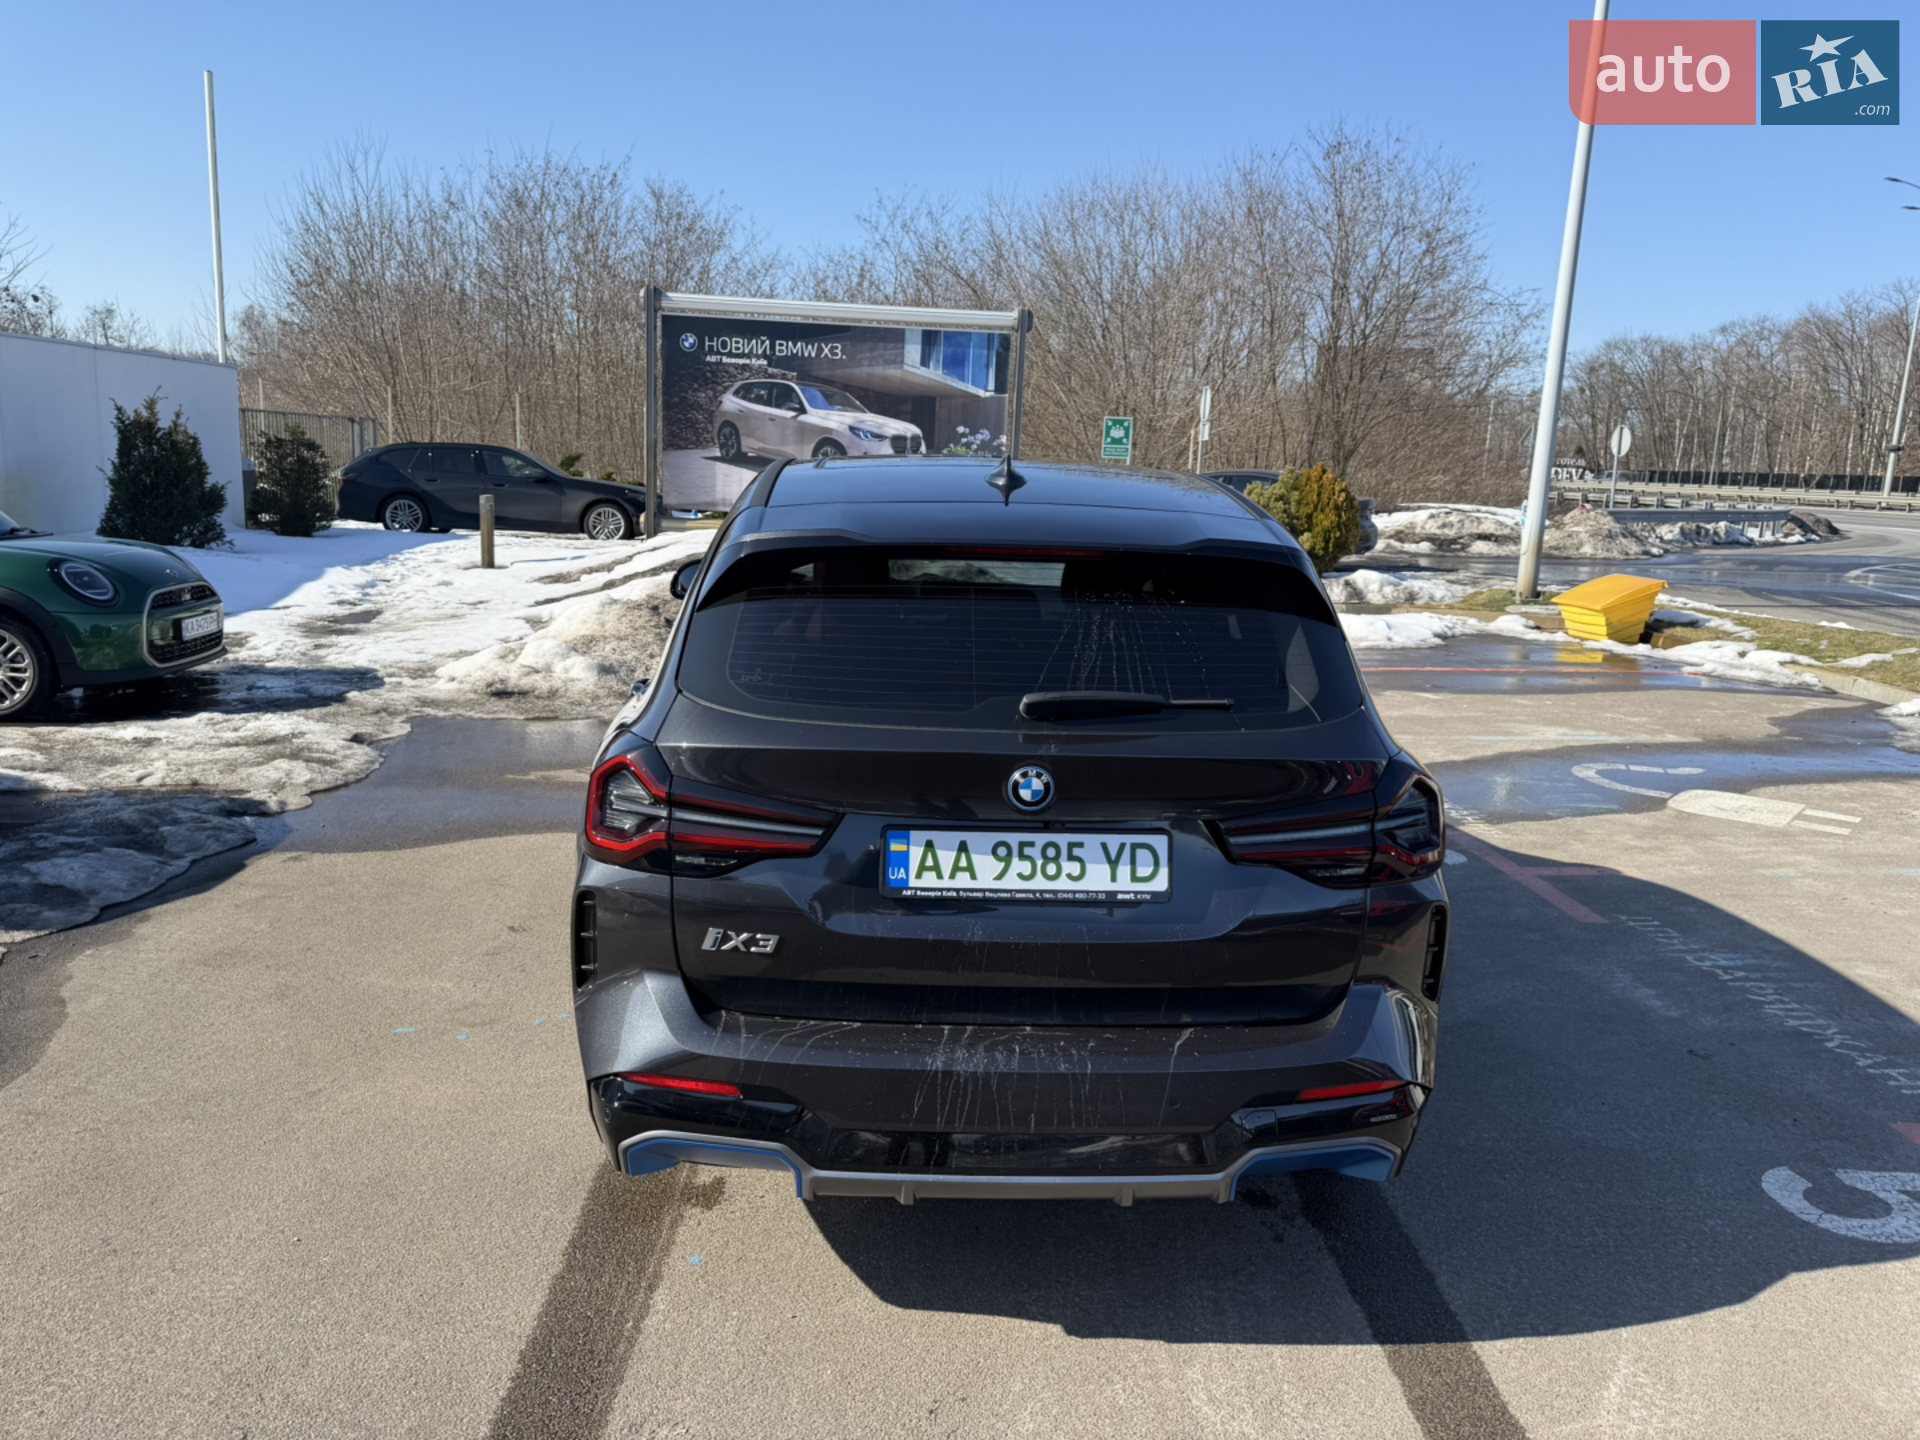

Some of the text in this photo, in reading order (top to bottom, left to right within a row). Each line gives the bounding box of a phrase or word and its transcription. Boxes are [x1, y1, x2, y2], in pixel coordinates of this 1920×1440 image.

[705, 335, 770, 355] НОВИЙ
[775, 340, 818, 358] BMW
[820, 342, 846, 360] X3.
[888, 867, 907, 880] UA
[914, 839, 1161, 884] AA 9585 YD
